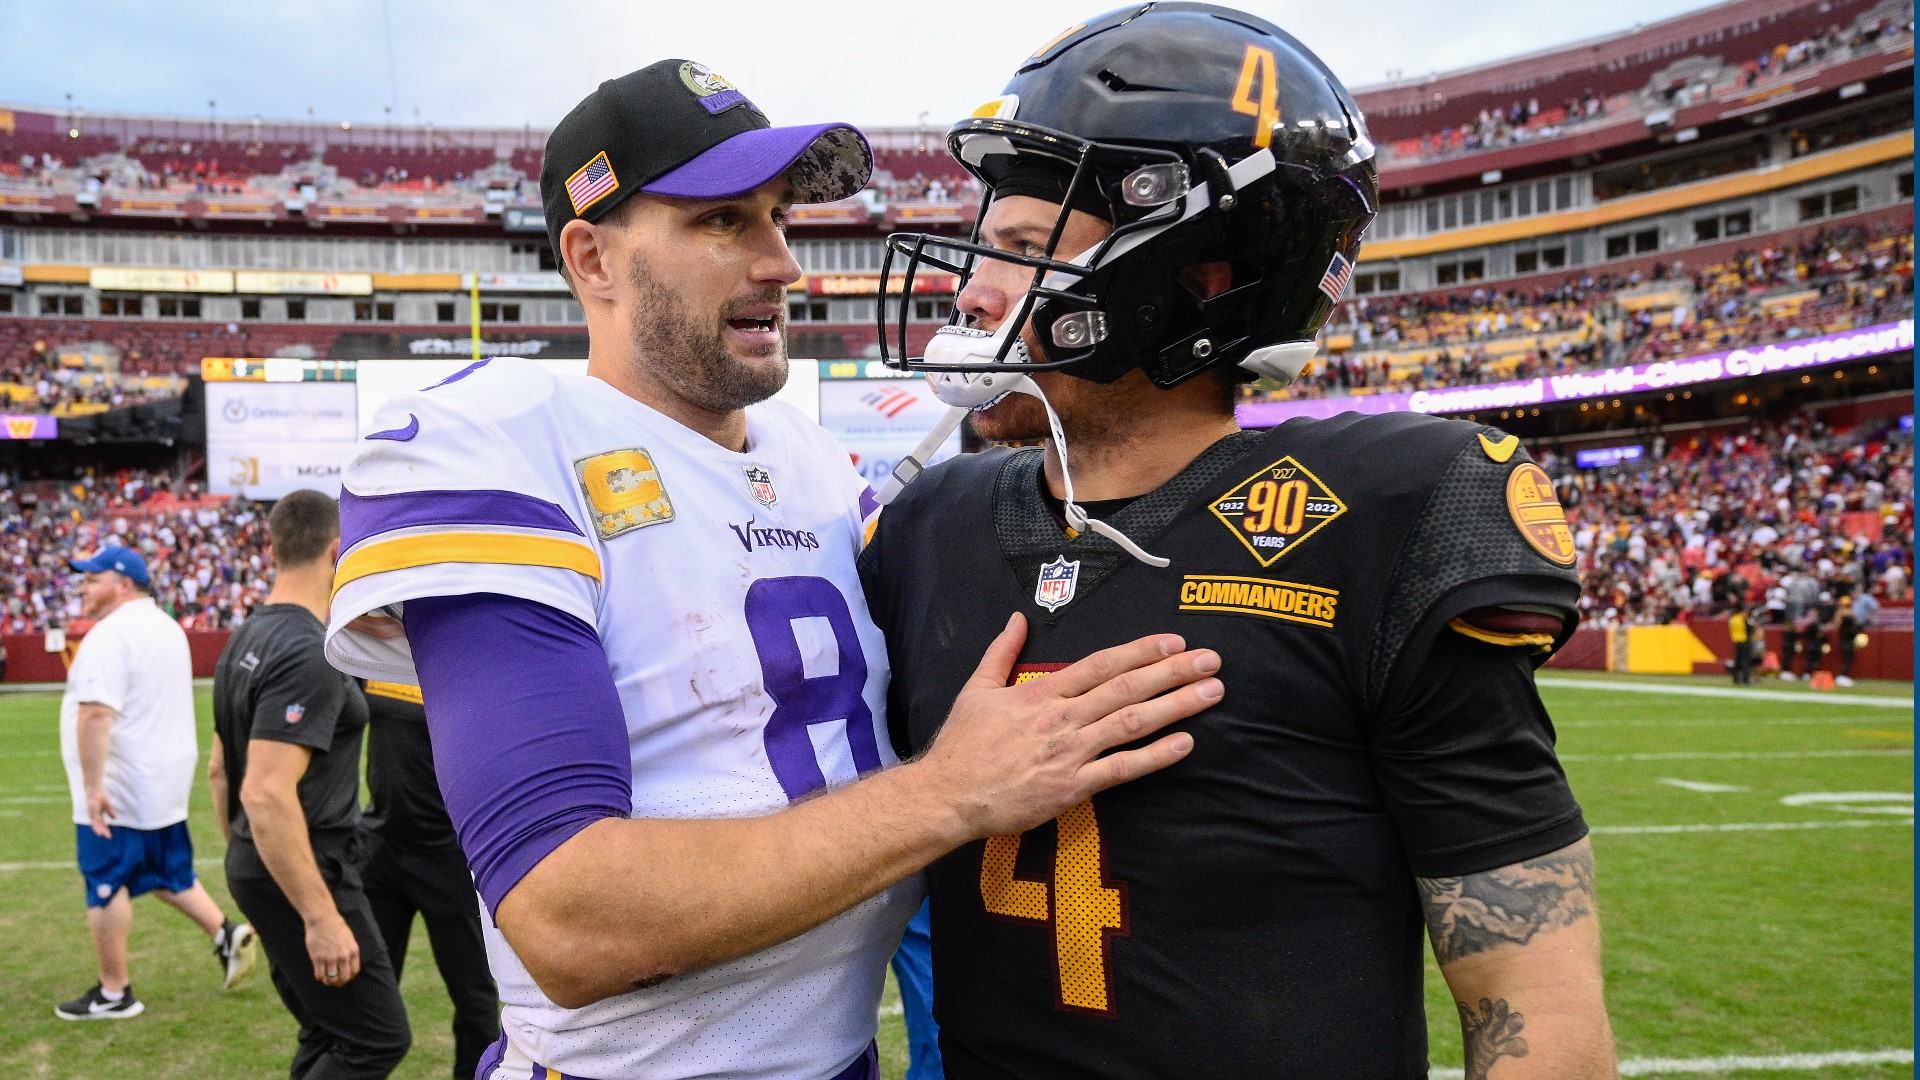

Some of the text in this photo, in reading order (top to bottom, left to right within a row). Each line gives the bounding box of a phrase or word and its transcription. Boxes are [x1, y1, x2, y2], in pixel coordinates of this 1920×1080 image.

[707, 90, 742, 110] VIKIN
[1230, 44, 1281, 149] 4
[1409, 378, 1543, 414] Command
[1551, 357, 1724, 400] World-Class
[583, 450, 661, 515] C
[754, 483, 776, 501] NFL
[1218, 502, 1245, 511] 1932
[1244, 480, 1309, 535] 90
[1306, 503, 1338, 513] 2022
[1252, 535, 1286, 548] YEARS
[1042, 580, 1068, 599] NFL
[1180, 581, 1338, 621] COMMANDERS
[744, 575, 883, 804] 8
[978, 663, 1130, 1018] 4
